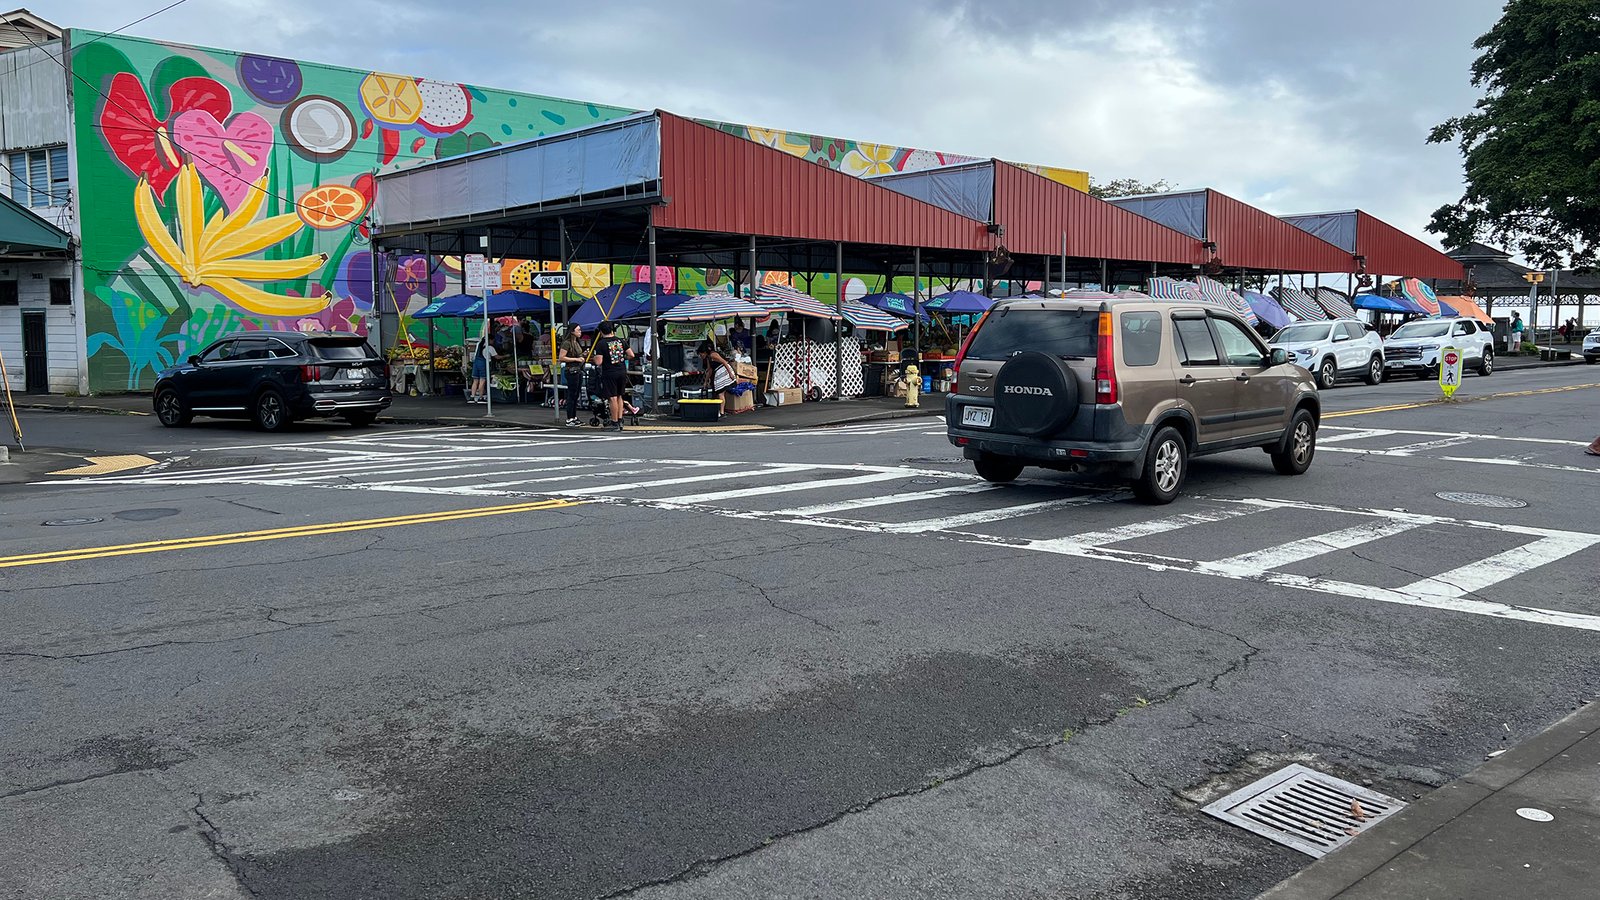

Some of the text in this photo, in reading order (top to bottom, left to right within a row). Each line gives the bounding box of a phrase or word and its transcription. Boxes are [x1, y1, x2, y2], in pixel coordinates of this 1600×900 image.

[541, 276, 565, 285] ONE WAY
[1003, 385, 1054, 397] HONDA
[964, 410, 978, 422] JYZ
